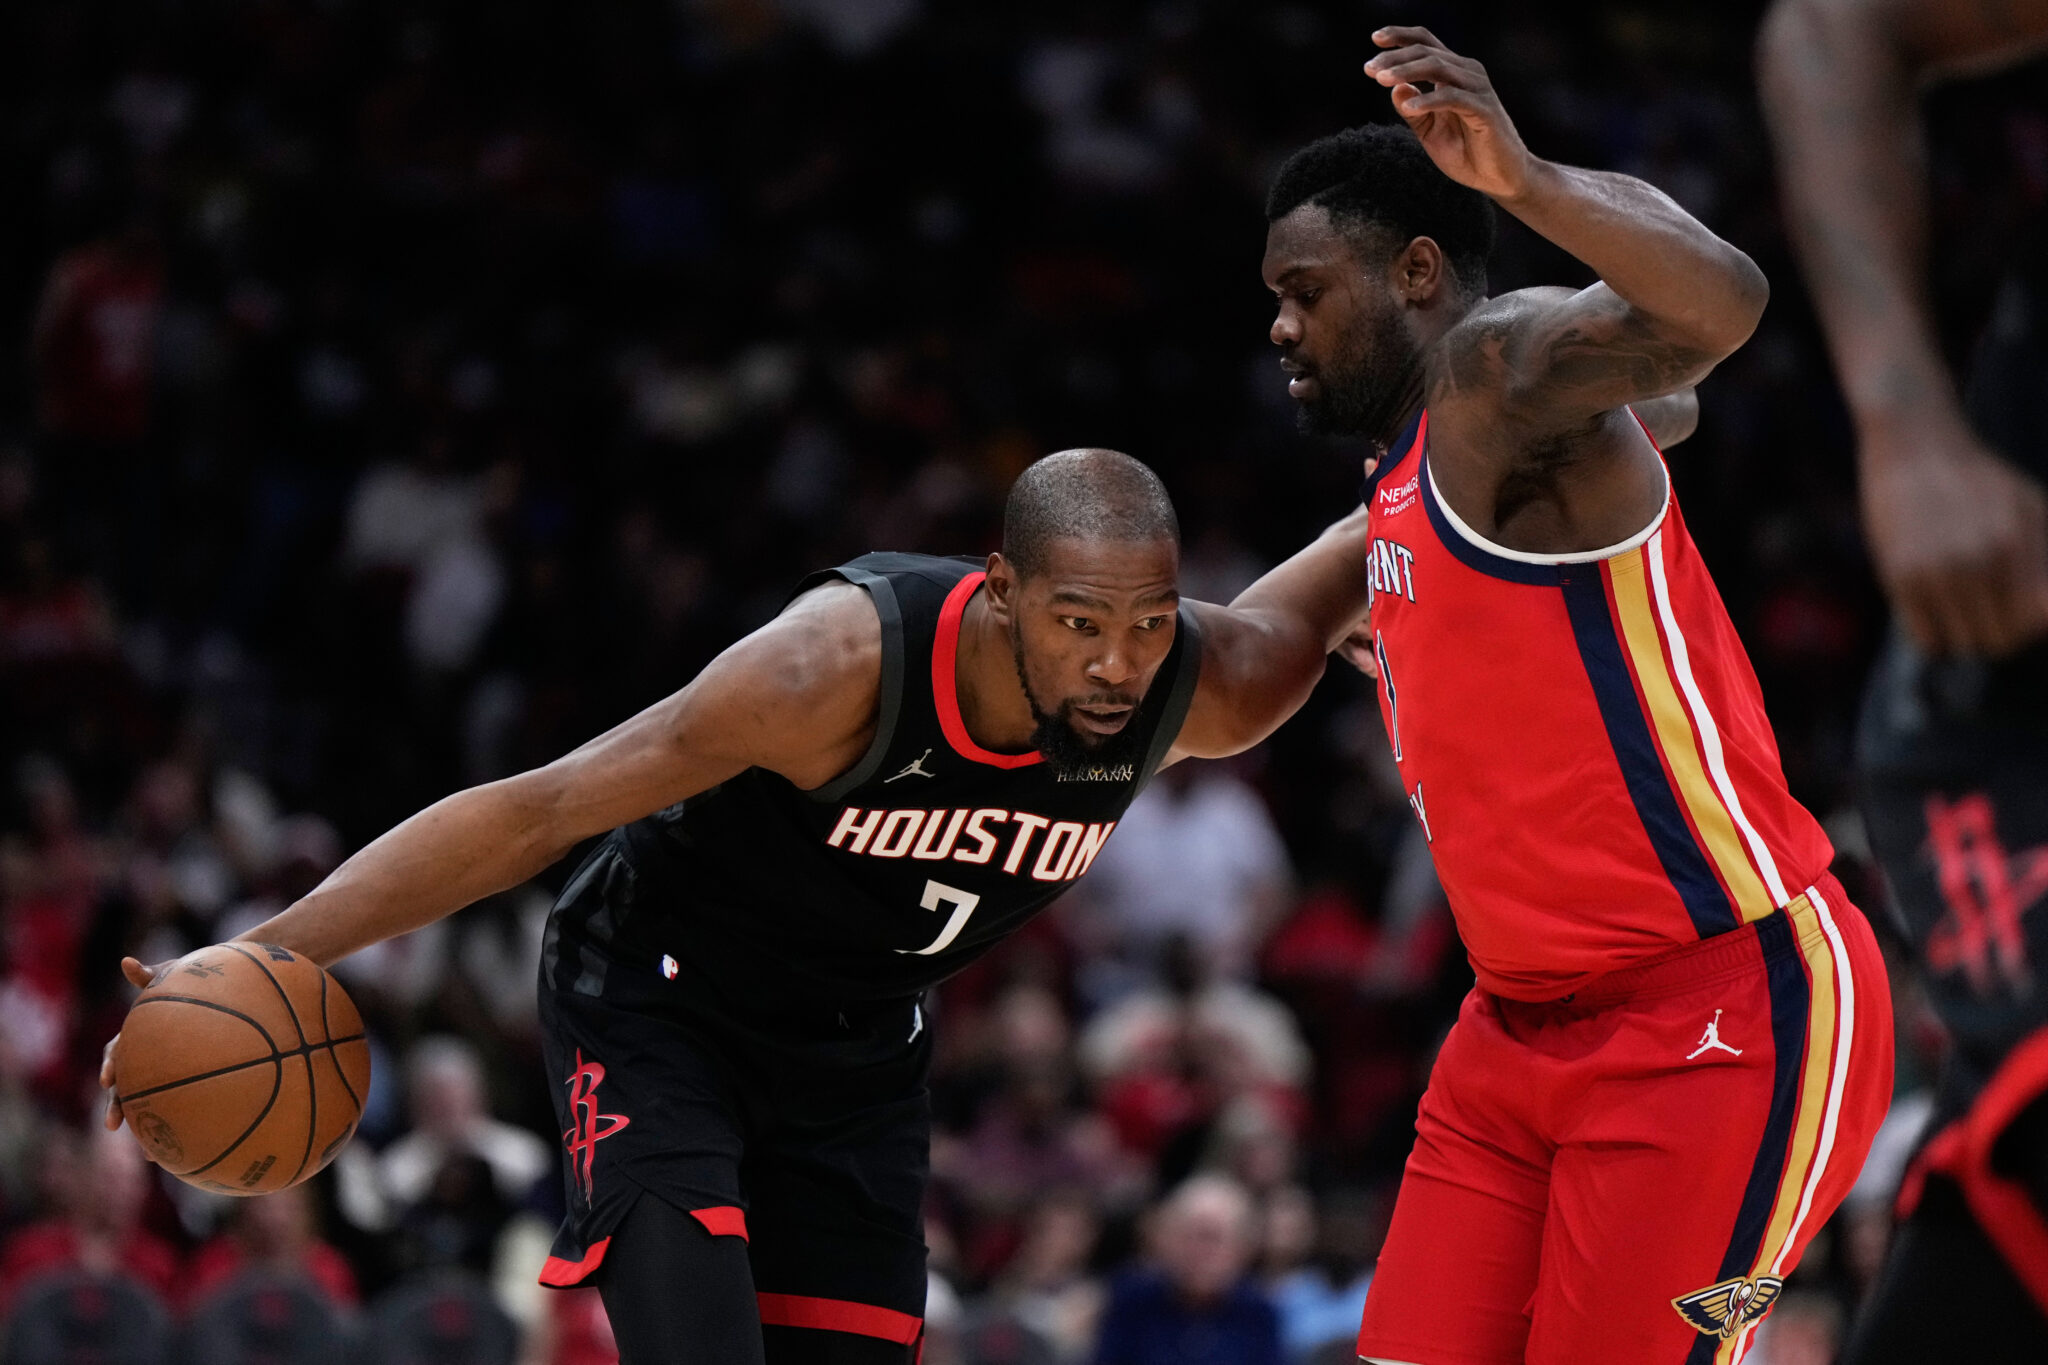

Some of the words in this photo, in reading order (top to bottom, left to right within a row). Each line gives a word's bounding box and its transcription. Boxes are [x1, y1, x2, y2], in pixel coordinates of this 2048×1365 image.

[1384, 494, 1416, 516] PRODUCTS
[825, 806, 1117, 882] HOUSTON
[892, 879, 981, 956] 7
